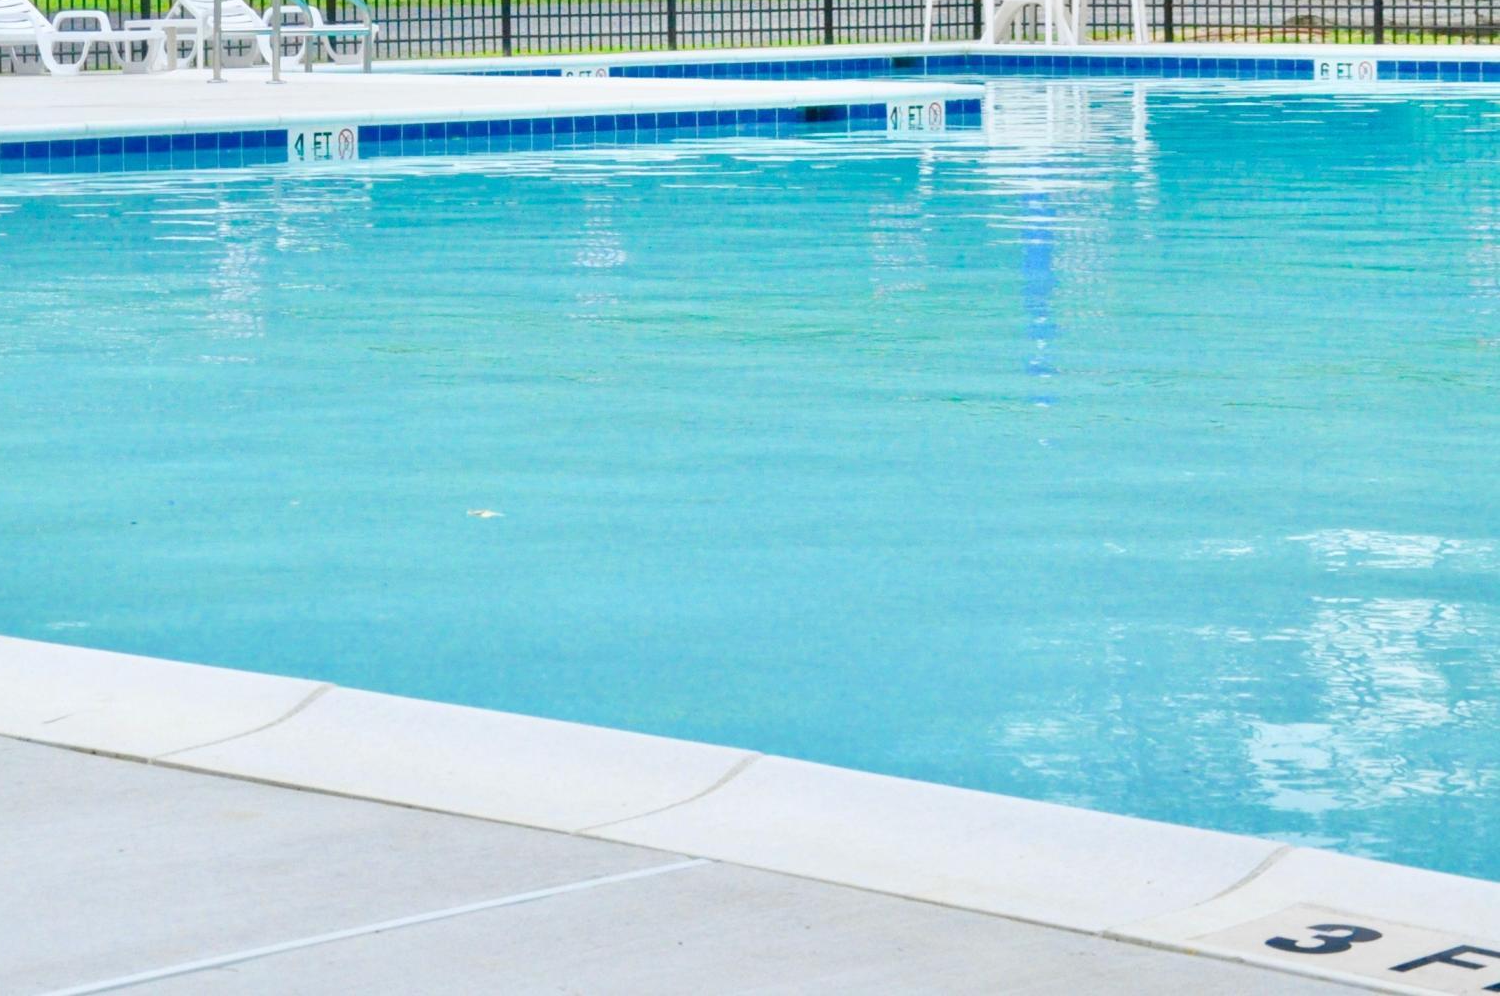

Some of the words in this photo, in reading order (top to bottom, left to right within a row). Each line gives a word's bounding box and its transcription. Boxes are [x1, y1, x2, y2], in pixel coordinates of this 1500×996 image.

[313, 132, 332, 161] FT
[1264, 923, 1383, 955] 3
[1388, 944, 1500, 993] F
